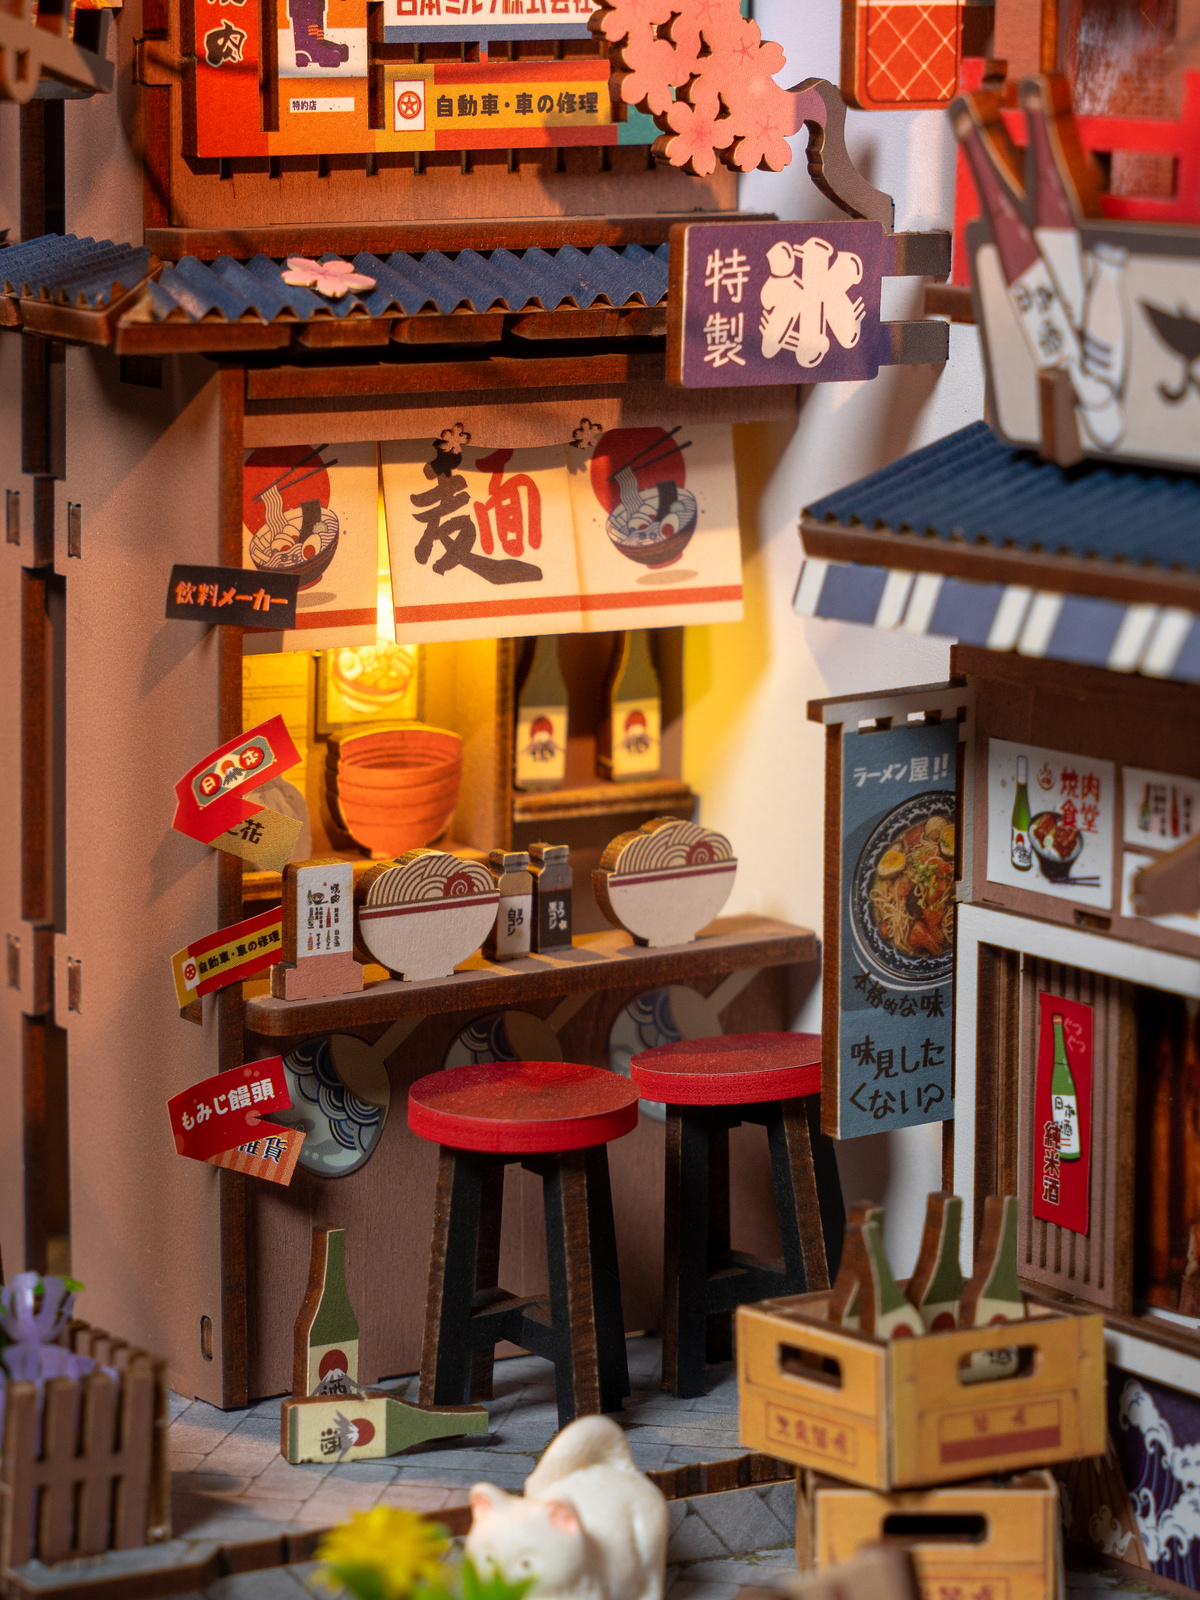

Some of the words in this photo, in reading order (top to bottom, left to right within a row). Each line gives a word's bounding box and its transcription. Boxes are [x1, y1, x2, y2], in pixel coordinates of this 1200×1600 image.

[204, 0, 248, 68] 肉
[436, 91, 599, 118] 自動車・車の修理
[704, 247, 750, 368] 特製
[174, 579, 289, 612] 飲料メーカー
[851, 1035, 946, 1081] 味見した
[181, 1077, 276, 1131] もみじ饅頭
